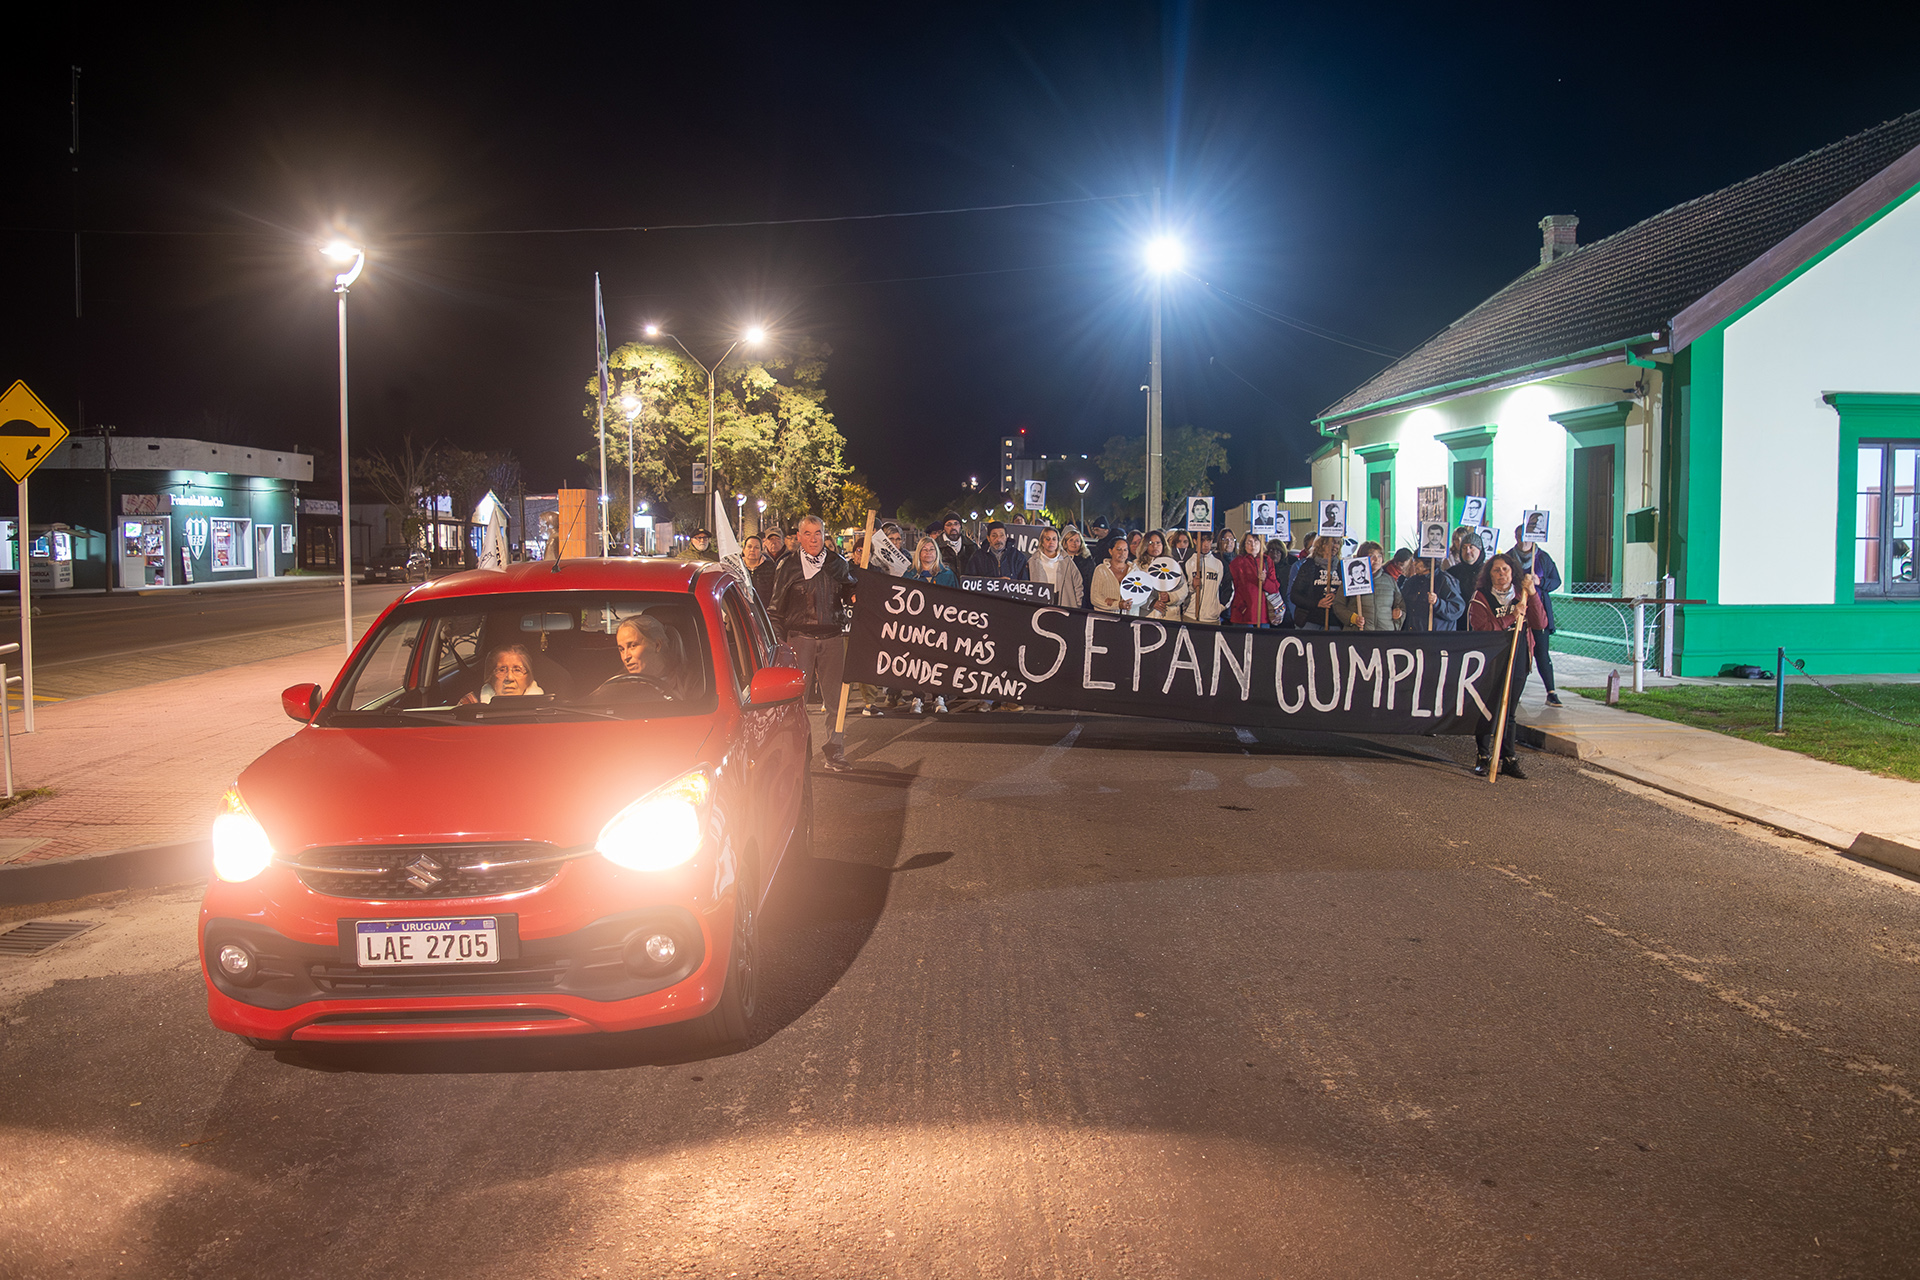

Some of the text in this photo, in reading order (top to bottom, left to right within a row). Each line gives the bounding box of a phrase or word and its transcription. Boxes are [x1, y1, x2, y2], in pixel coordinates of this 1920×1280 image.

[882, 538, 907, 564] PRESENTE
[884, 585, 925, 616] 30
[932, 603, 989, 629] veces
[962, 579, 982, 591] QUE
[986, 580, 1000, 592] SE
[1002, 582, 1034, 596] ACABE
[1037, 586, 1051, 600] LA
[881, 621, 996, 665] NUNCA MÁS
[1018, 606, 1254, 701] SEPAN
[876, 651, 1028, 701] DÓNDE ESTÁN?
[402, 922, 452, 931] URUGUAY
[367, 934, 488, 960] LAE 2705
